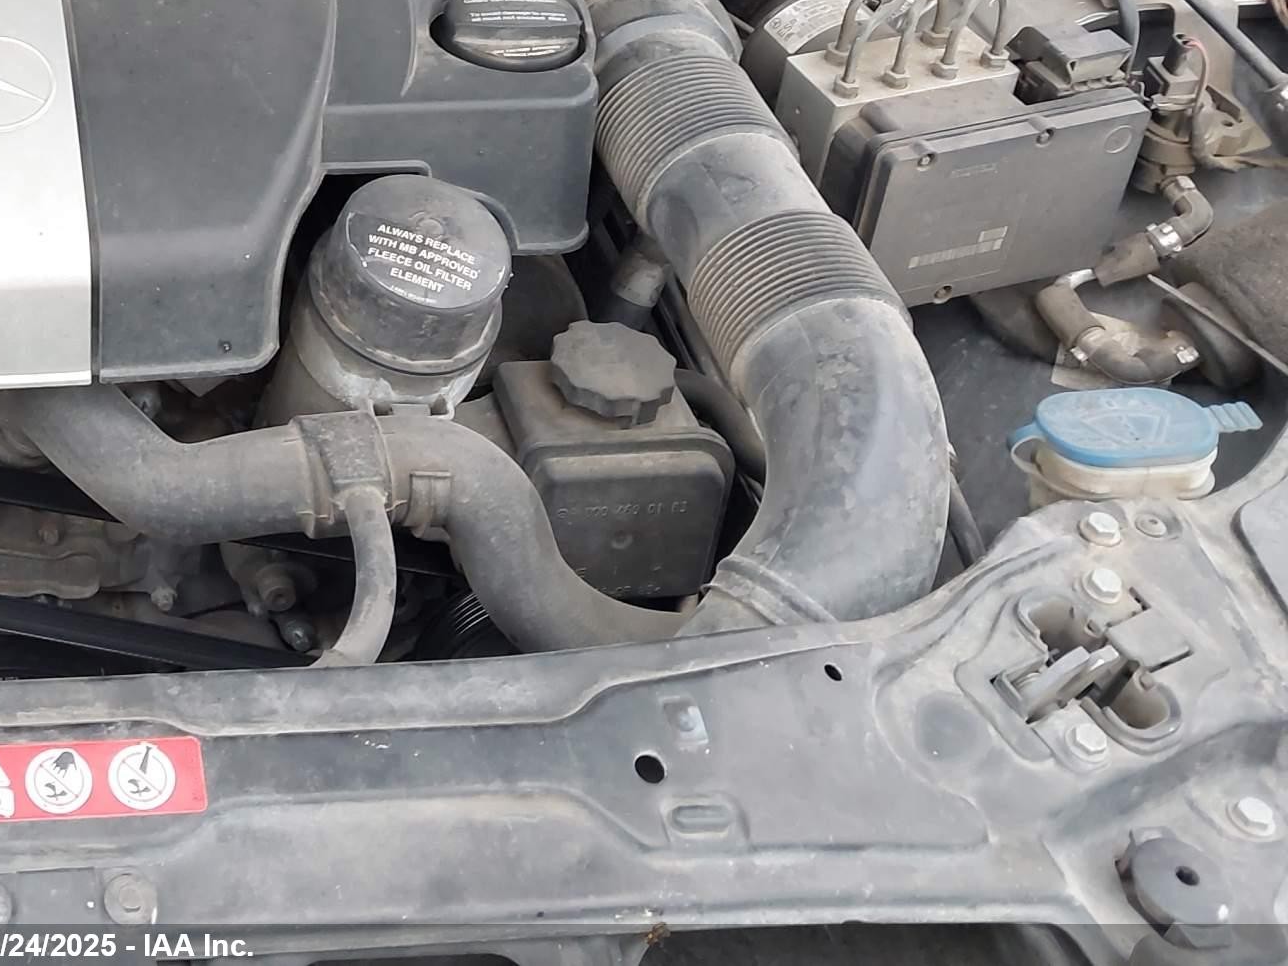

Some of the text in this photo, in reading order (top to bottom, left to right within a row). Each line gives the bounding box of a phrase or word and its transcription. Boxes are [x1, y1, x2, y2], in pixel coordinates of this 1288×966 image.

[368, 234, 479, 280] WITH MB APPROVED
[377, 224, 475, 265] ALWAYS REPLACE
[368, 247, 473, 291] FLEECE OIL FILTER
[390, 267, 445, 293] ELEMENT
